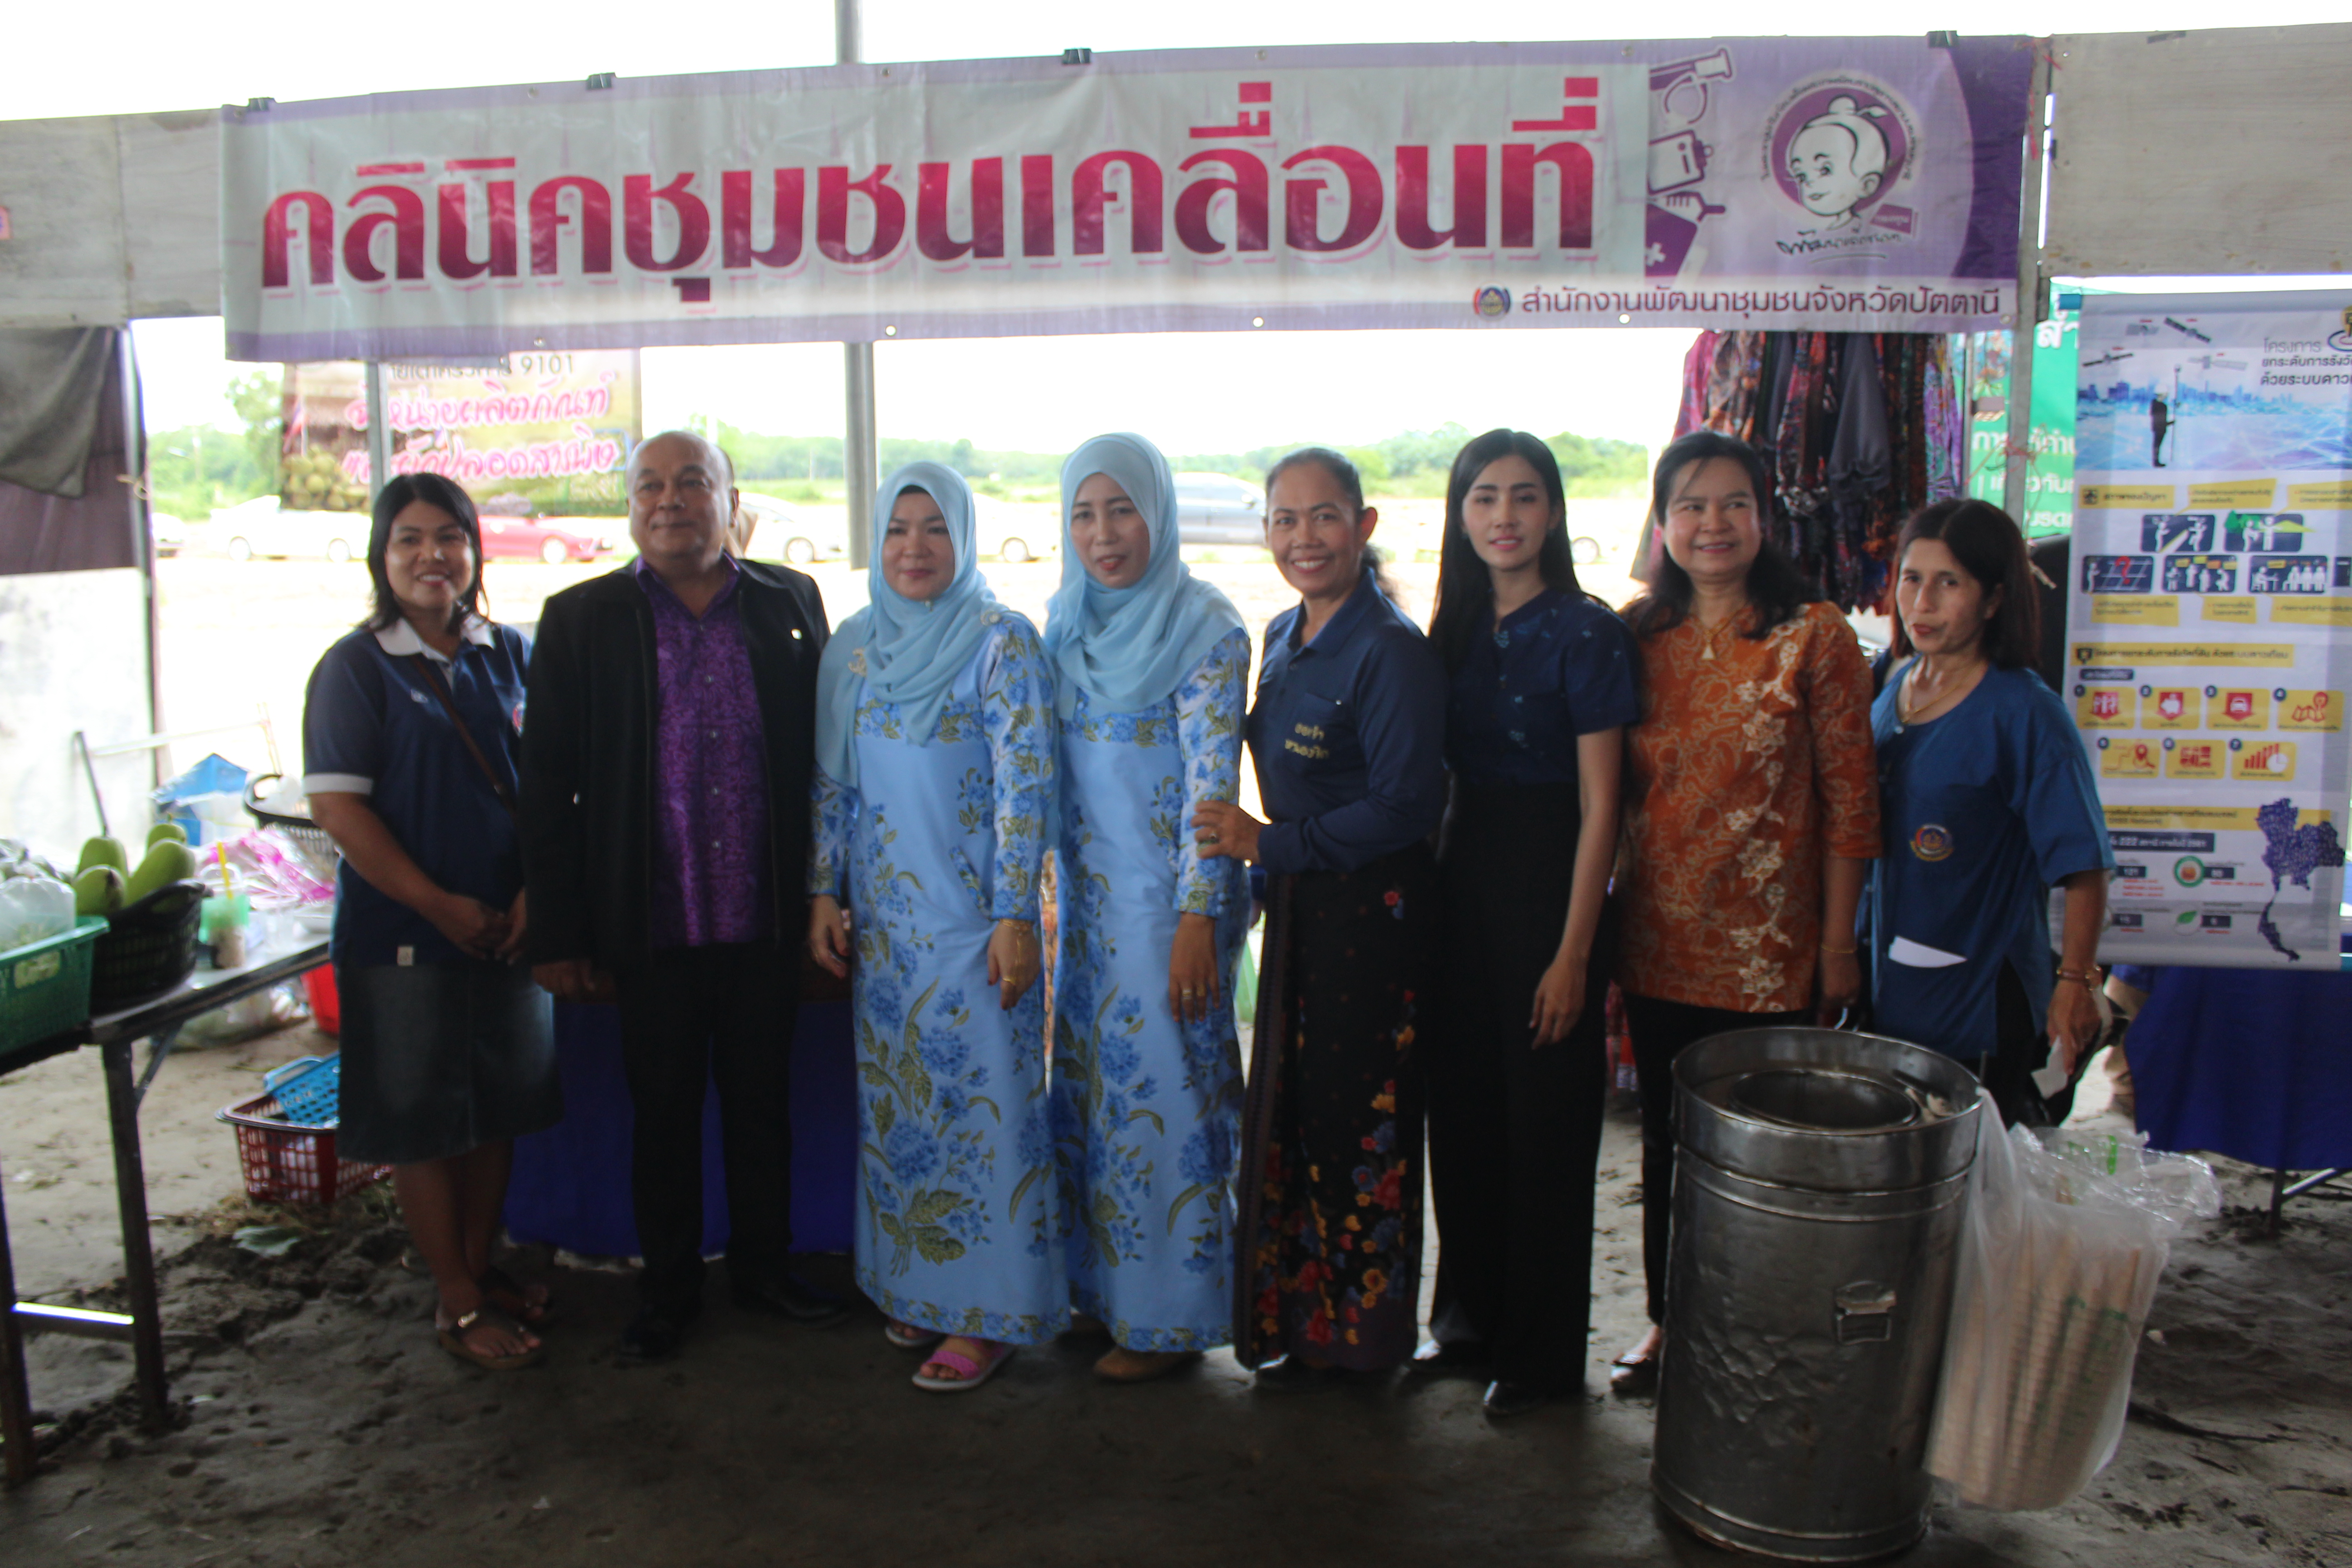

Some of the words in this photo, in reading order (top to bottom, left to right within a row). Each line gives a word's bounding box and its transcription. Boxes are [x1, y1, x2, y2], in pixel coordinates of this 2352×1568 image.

[261, 77, 1598, 304] คลินิคชุมชนเคลื่อนที่
[1522, 284, 1999, 322] สำนักงานพัฒนาชุมชนจังหวัดปัตตานี
[2263, 337, 2321, 353] โครงการ
[520, 354, 573, 375] 9101
[2262, 355, 2352, 367] ยกระดับการรังวั
